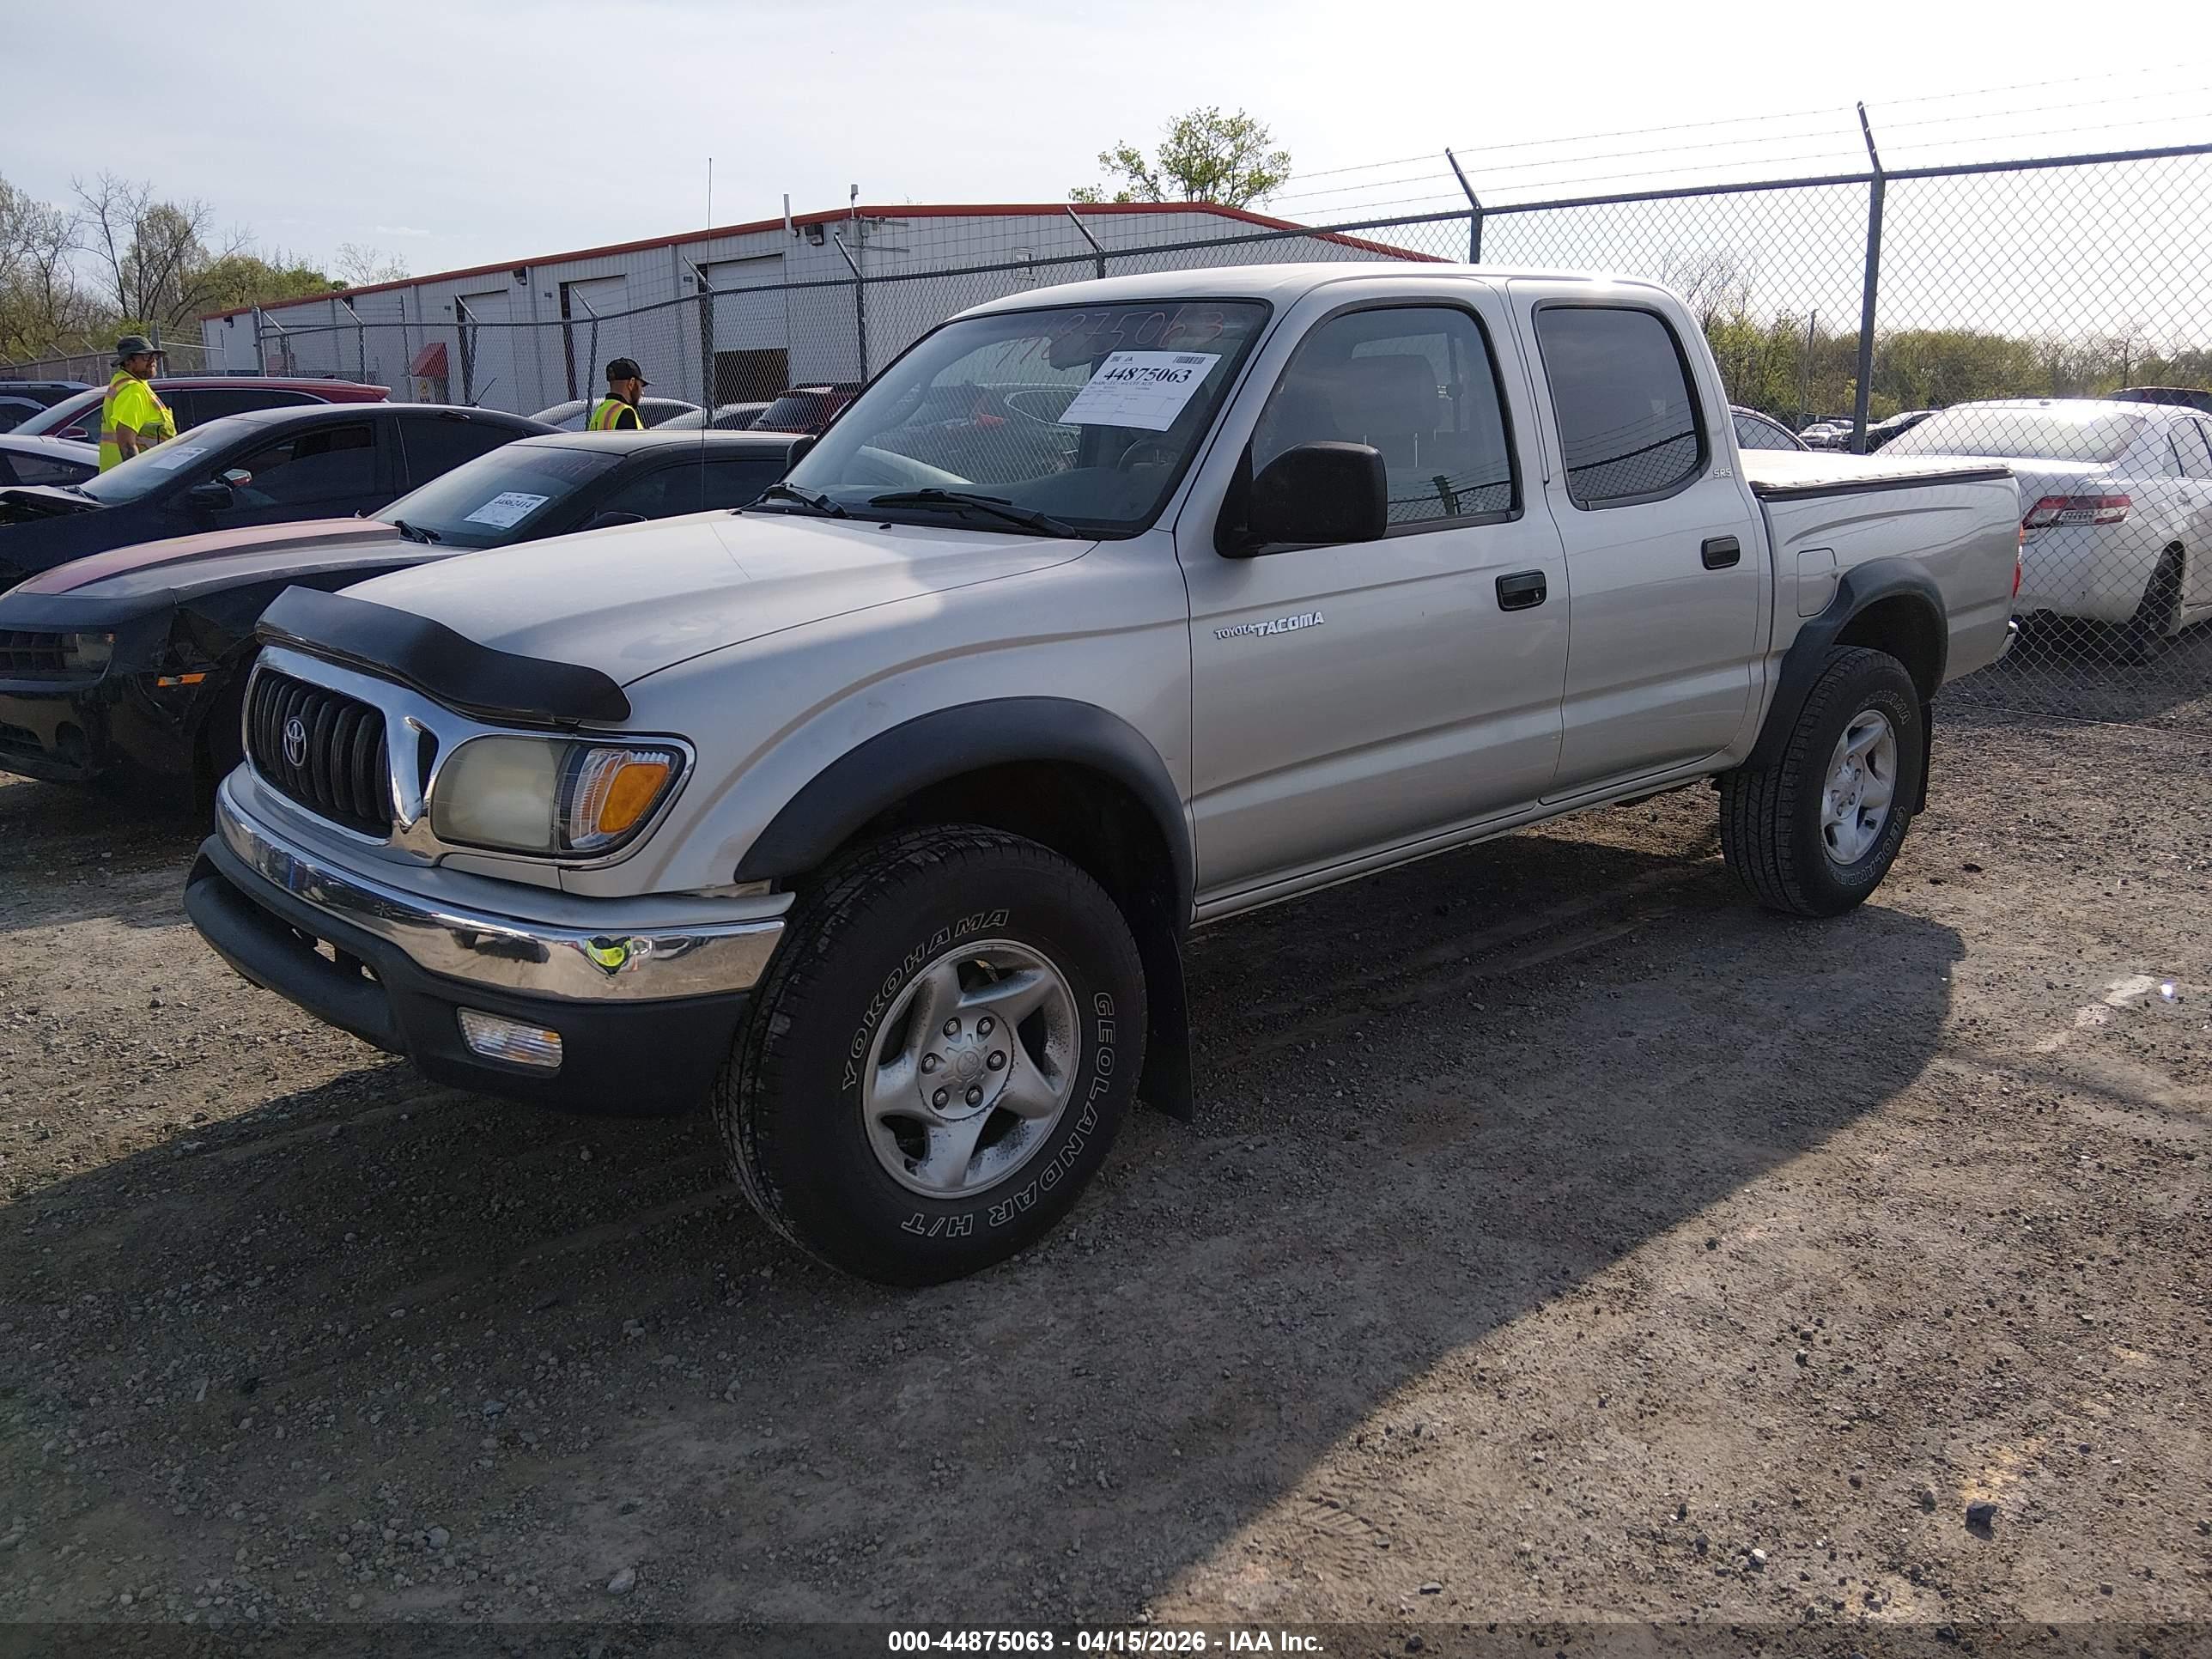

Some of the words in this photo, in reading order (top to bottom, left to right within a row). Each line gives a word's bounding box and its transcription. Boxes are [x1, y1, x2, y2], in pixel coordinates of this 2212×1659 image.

[1103, 367, 1193, 384] 44875063
[1713, 468, 1733, 479] SRS
[1214, 623, 1255, 640] TOYOTA
[1254, 611, 1325, 636] TACOMA
[842, 908, 1010, 1091] YOKOHAMA
[988, 992, 1115, 1228] GEOLANDAR
[900, 1212, 974, 1238] H/T
